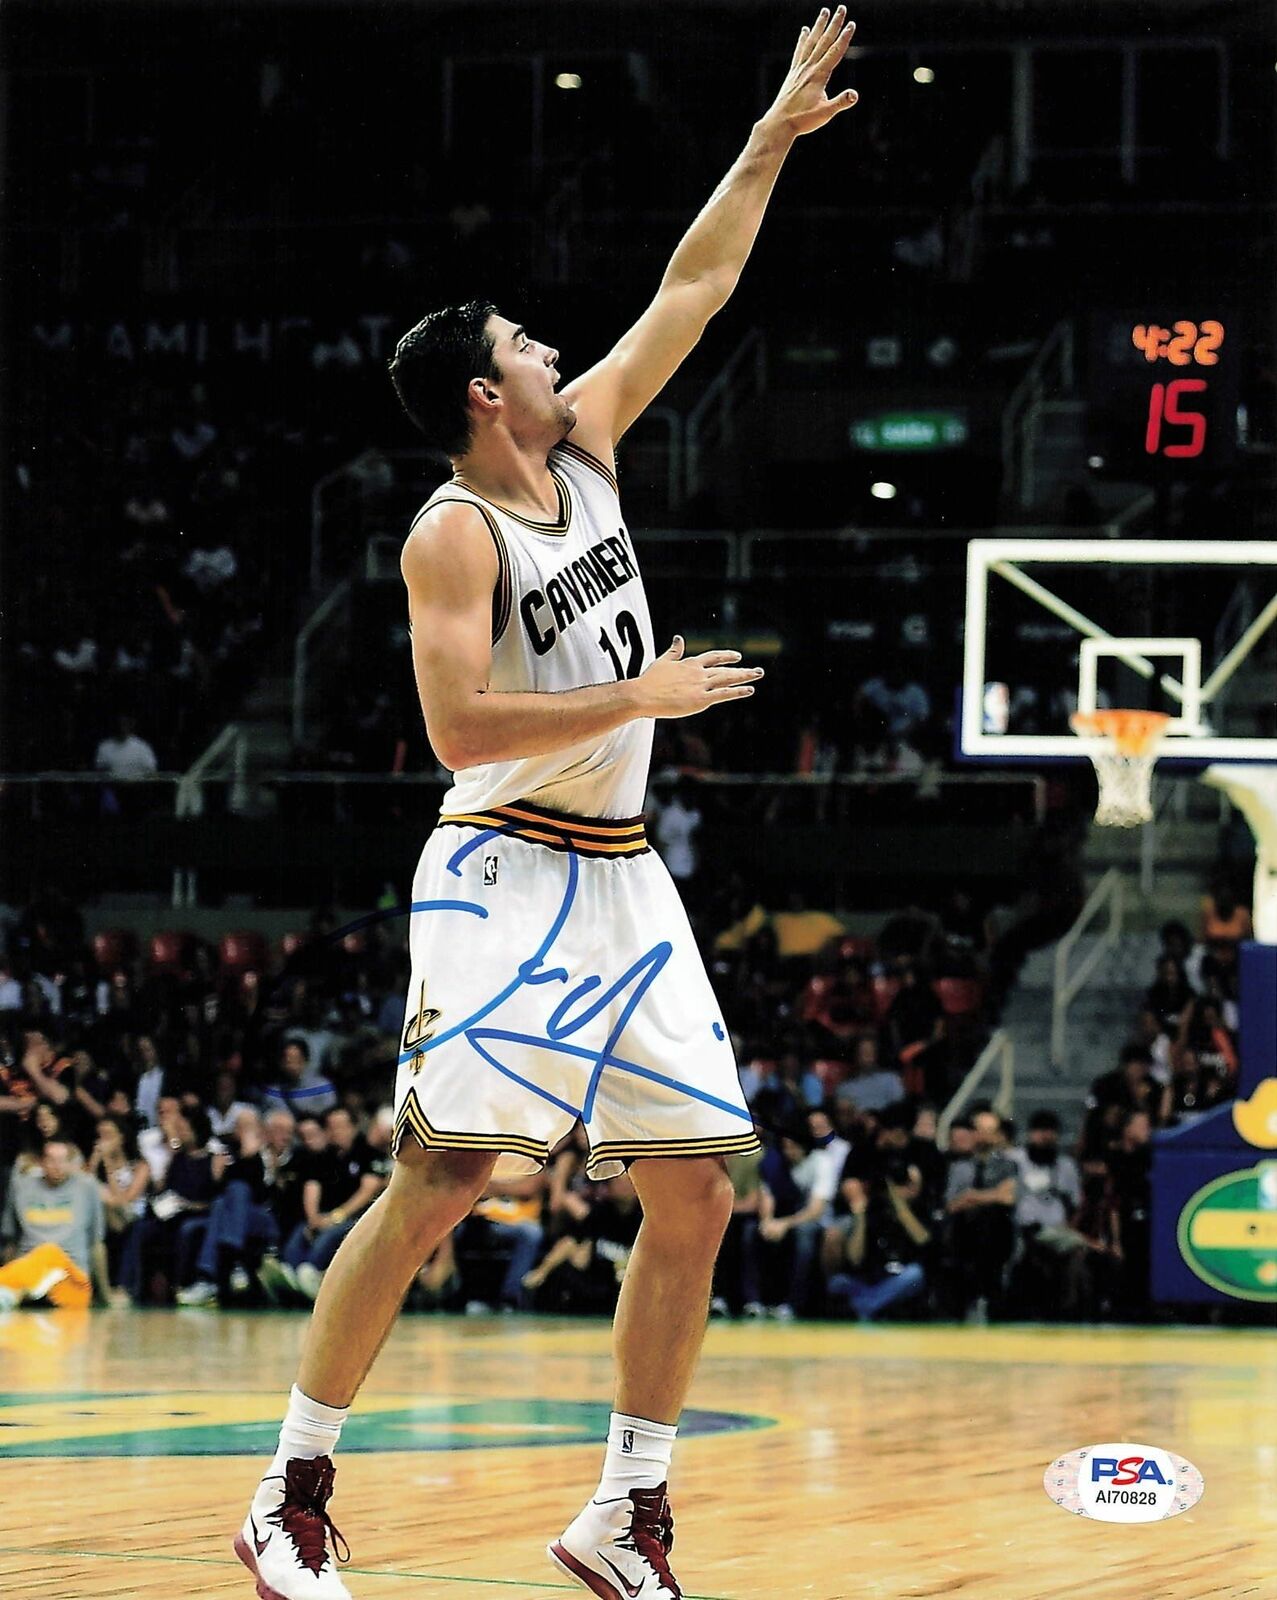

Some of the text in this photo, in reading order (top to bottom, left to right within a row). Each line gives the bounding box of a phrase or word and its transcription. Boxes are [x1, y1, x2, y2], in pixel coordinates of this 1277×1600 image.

[32, 318, 209, 365] MAMI
[1132, 320, 1225, 366] 4:22
[1145, 379, 1207, 458] 15
[598, 610, 645, 681] 12
